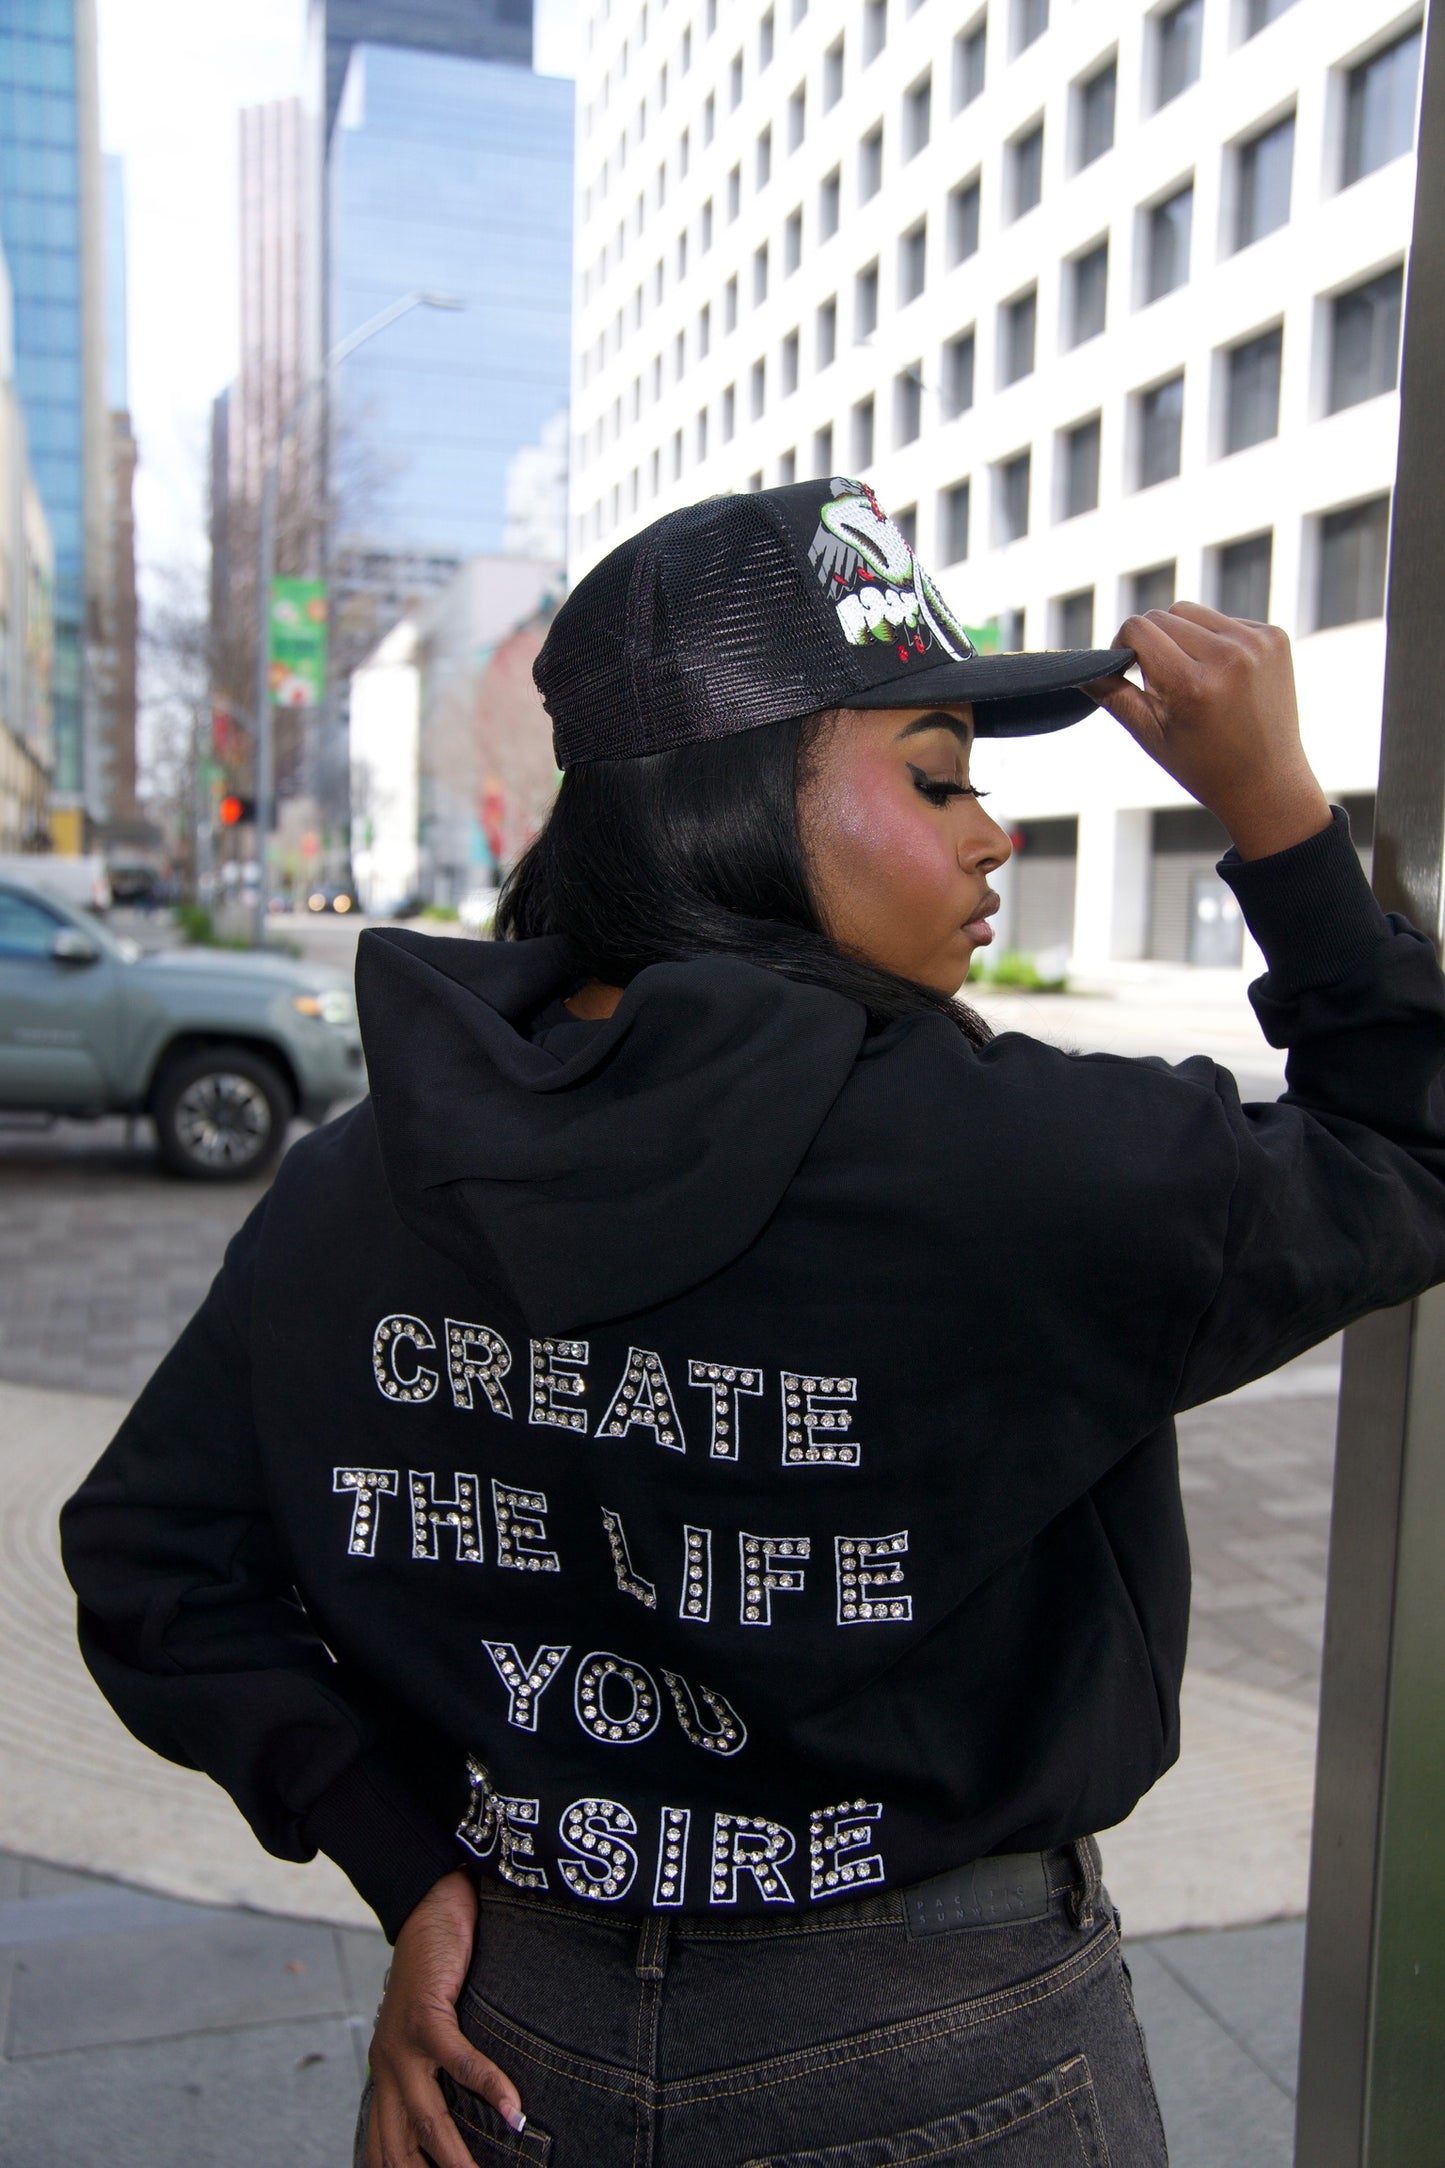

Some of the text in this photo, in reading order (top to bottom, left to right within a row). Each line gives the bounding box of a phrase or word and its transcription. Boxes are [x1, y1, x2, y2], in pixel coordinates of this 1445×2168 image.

[373, 1314, 861, 1466] CREATE
[333, 1467, 912, 1625] THE LIFE
[481, 1639, 748, 1756] YOU
[917, 1885, 1025, 1910] PACIC
